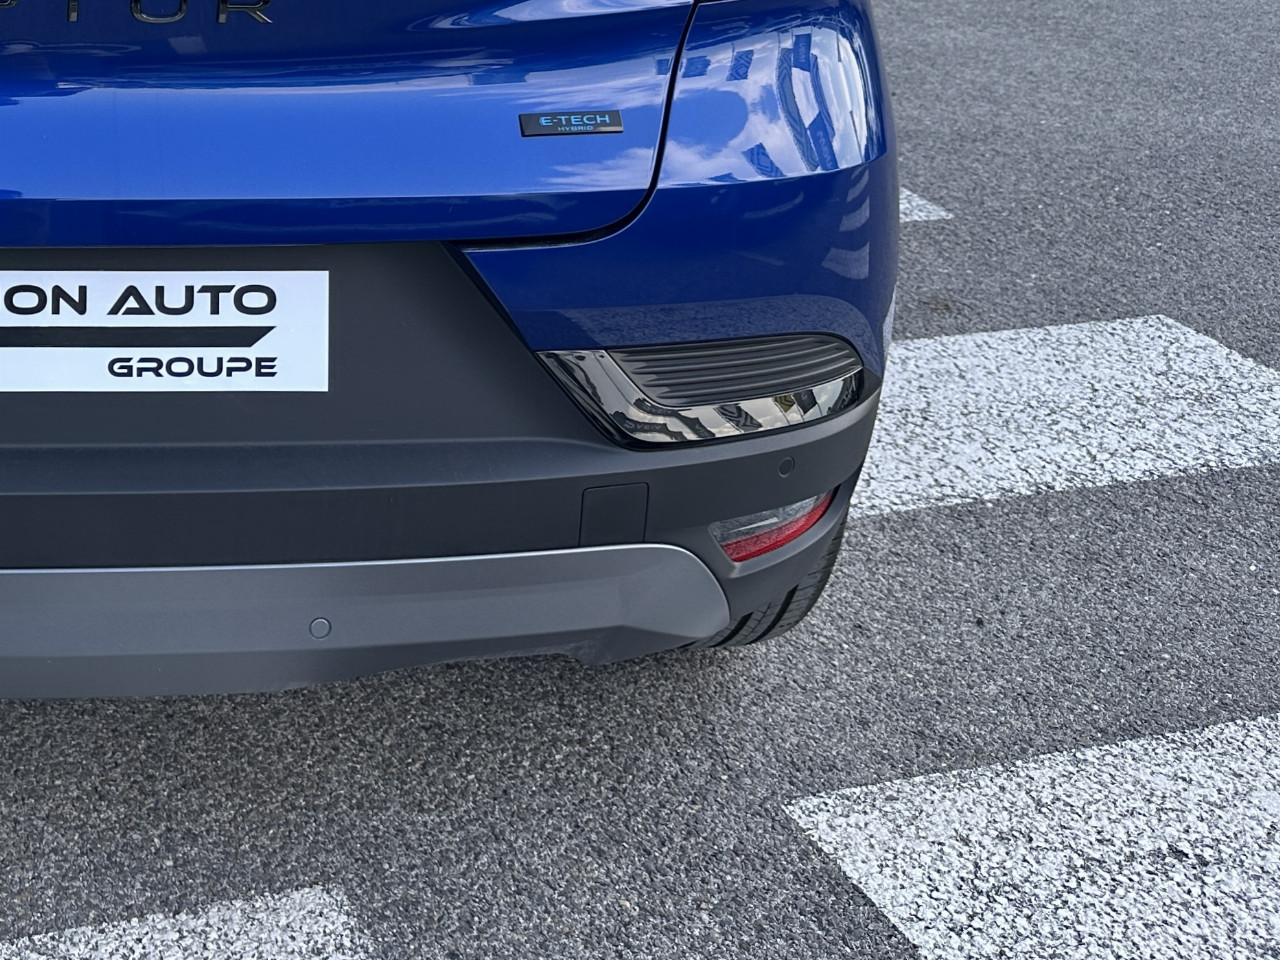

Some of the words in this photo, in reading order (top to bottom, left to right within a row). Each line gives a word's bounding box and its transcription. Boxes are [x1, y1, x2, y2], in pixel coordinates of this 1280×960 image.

[539, 114, 610, 126] E-TECH
[106, 283, 278, 316] AUTO
[106, 355, 278, 379] GROUPE
